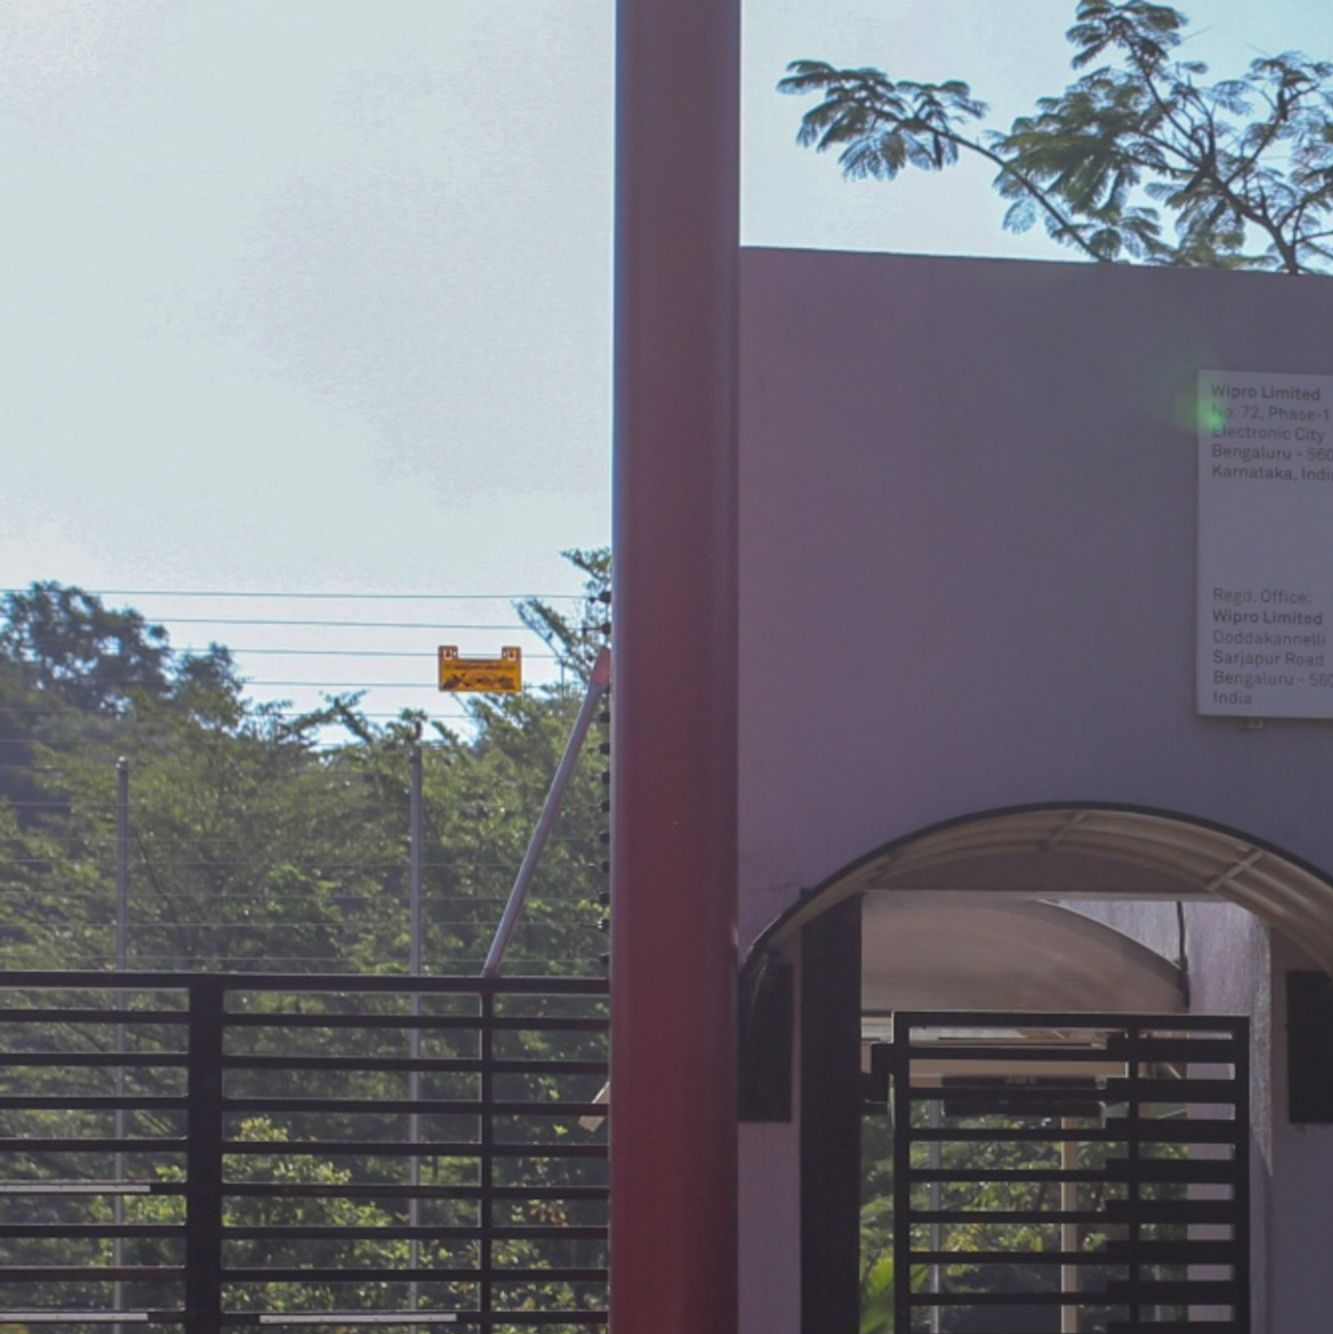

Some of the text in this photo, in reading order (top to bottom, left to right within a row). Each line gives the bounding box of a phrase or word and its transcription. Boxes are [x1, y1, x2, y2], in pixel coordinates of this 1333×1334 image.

[1211, 384, 1320, 400] Wipro Limited
[1240, 405, 1264, 421] 72,
[1268, 406, 1329, 423] Phase-1
[1211, 424, 1325, 444] Electronic City
[1211, 443, 1292, 462] Bengaluru
[1211, 465, 1298, 481] Karnataka,
[1213, 588, 1312, 605] Regd. Office:
[1213, 609, 1323, 625] Wipro Limited
[1213, 630, 1326, 646] Doddakannelli
[1213, 650, 1325, 667] Sarjapur Road
[1213, 670, 1294, 688] Bengaluru
[1213, 690, 1252, 705] India
